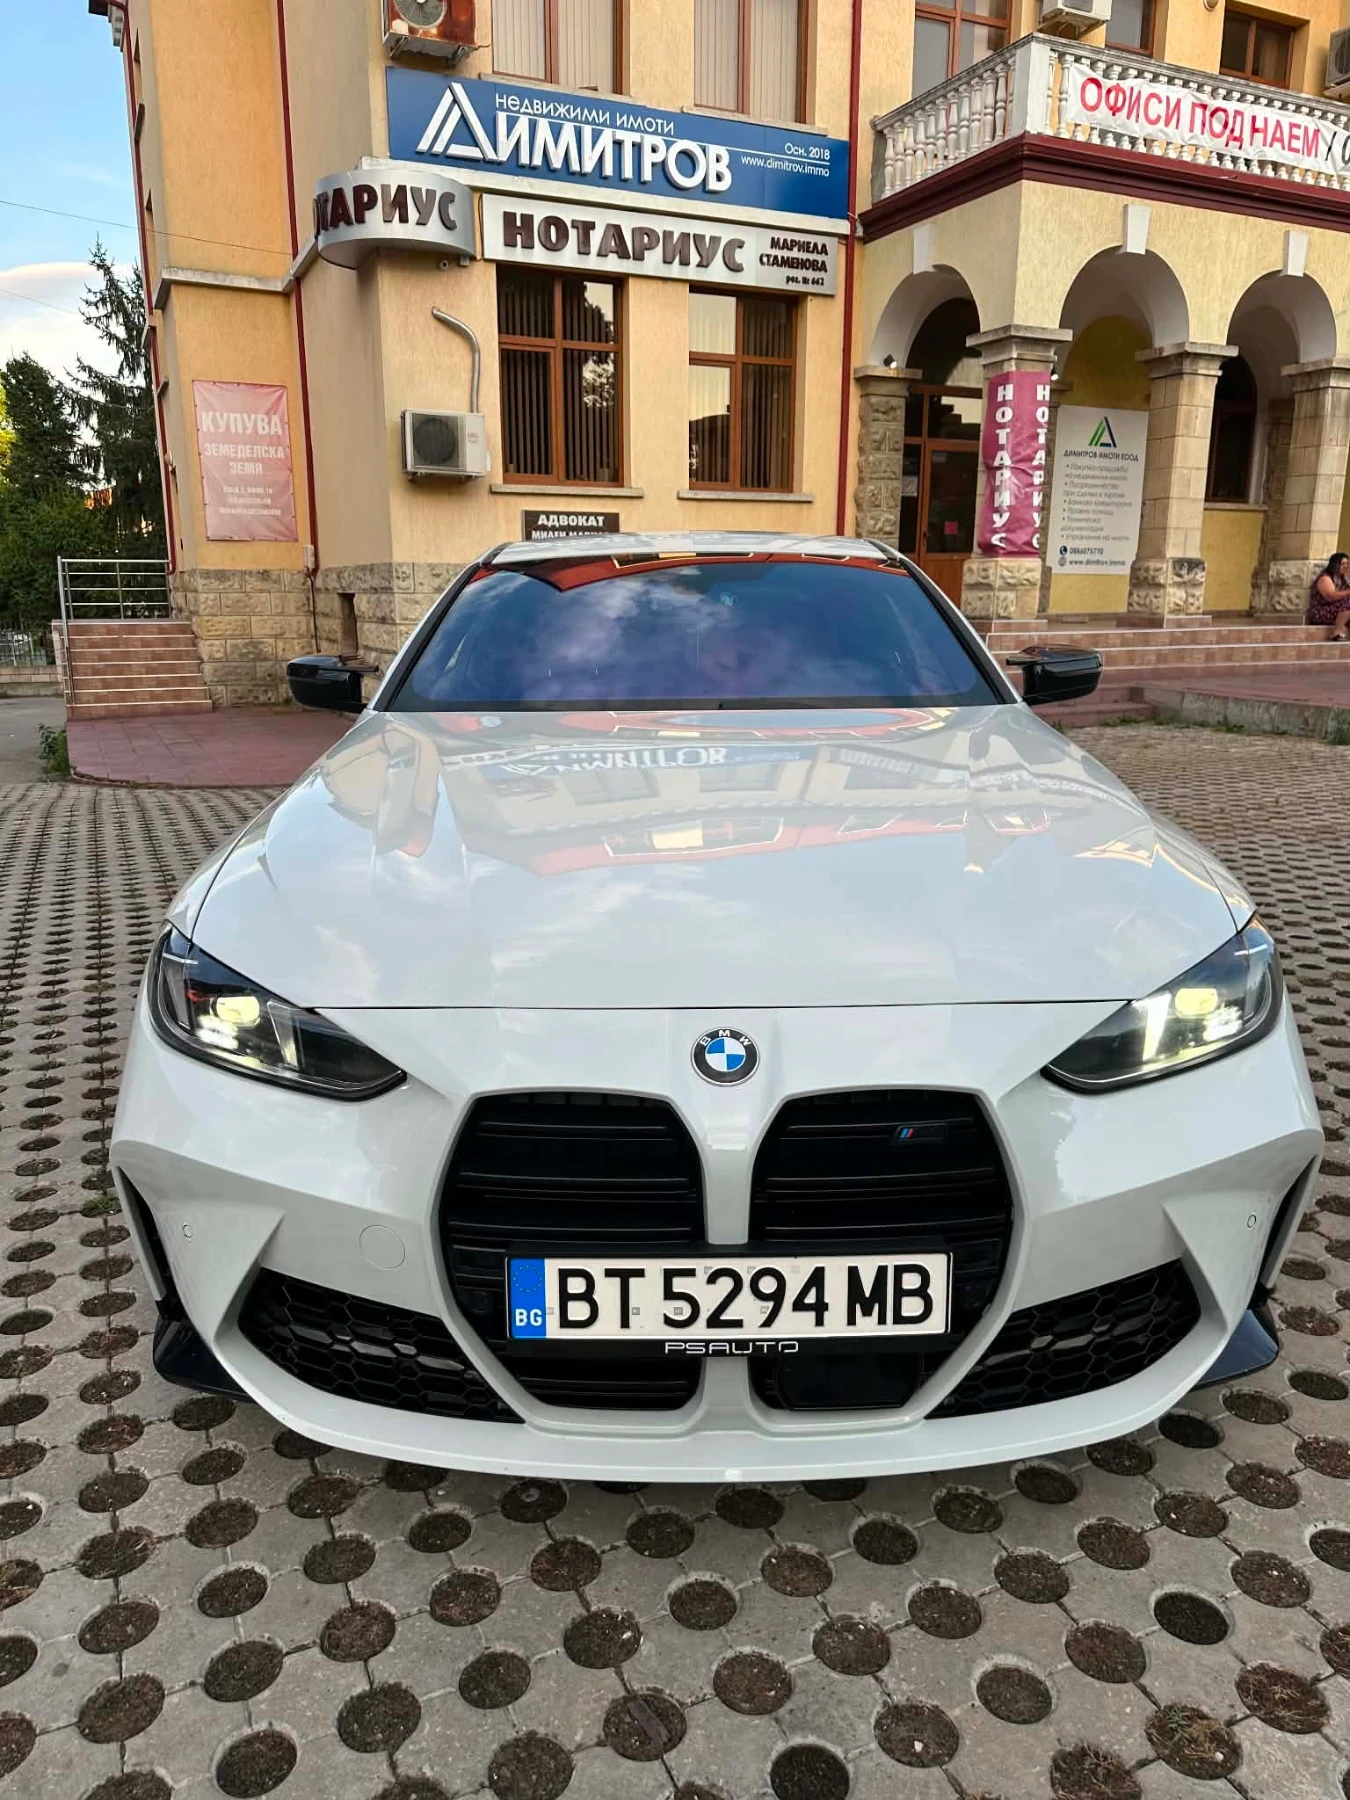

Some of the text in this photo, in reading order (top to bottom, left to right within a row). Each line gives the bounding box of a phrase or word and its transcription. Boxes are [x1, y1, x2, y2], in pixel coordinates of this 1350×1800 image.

[1080, 77, 1182, 131] ОФИСИ
[1188, 102, 1245, 150] ПОД
[1250, 115, 1320, 158] НАЕМ
[785, 143, 831, 160] Осн. 2018
[741, 155, 830, 177] www.dimitrov.immo
[502, 210, 745, 273] НОТАРИУС
[770, 236, 829, 256] МАРИЕЛА
[759, 253, 828, 273] СТАМЕНОВА
[201, 411, 283, 436] КУПУВА
[204, 442, 286, 459] ЗЕМЕДЕЛСКА
[1063, 450, 1097, 458] ДИМИТРОВ
[229, 462, 263, 475] ЗЕМЯ
[991, 383, 1014, 548] НОТАРИУС
[537, 514, 604, 527] АДВОКАТ
[699, 1029, 752, 1047] BMW
[558, 1263, 933, 1329] BT 5294 MB
[515, 1309, 543, 1327] BG
[664, 1340, 799, 1355] PSAUTO
